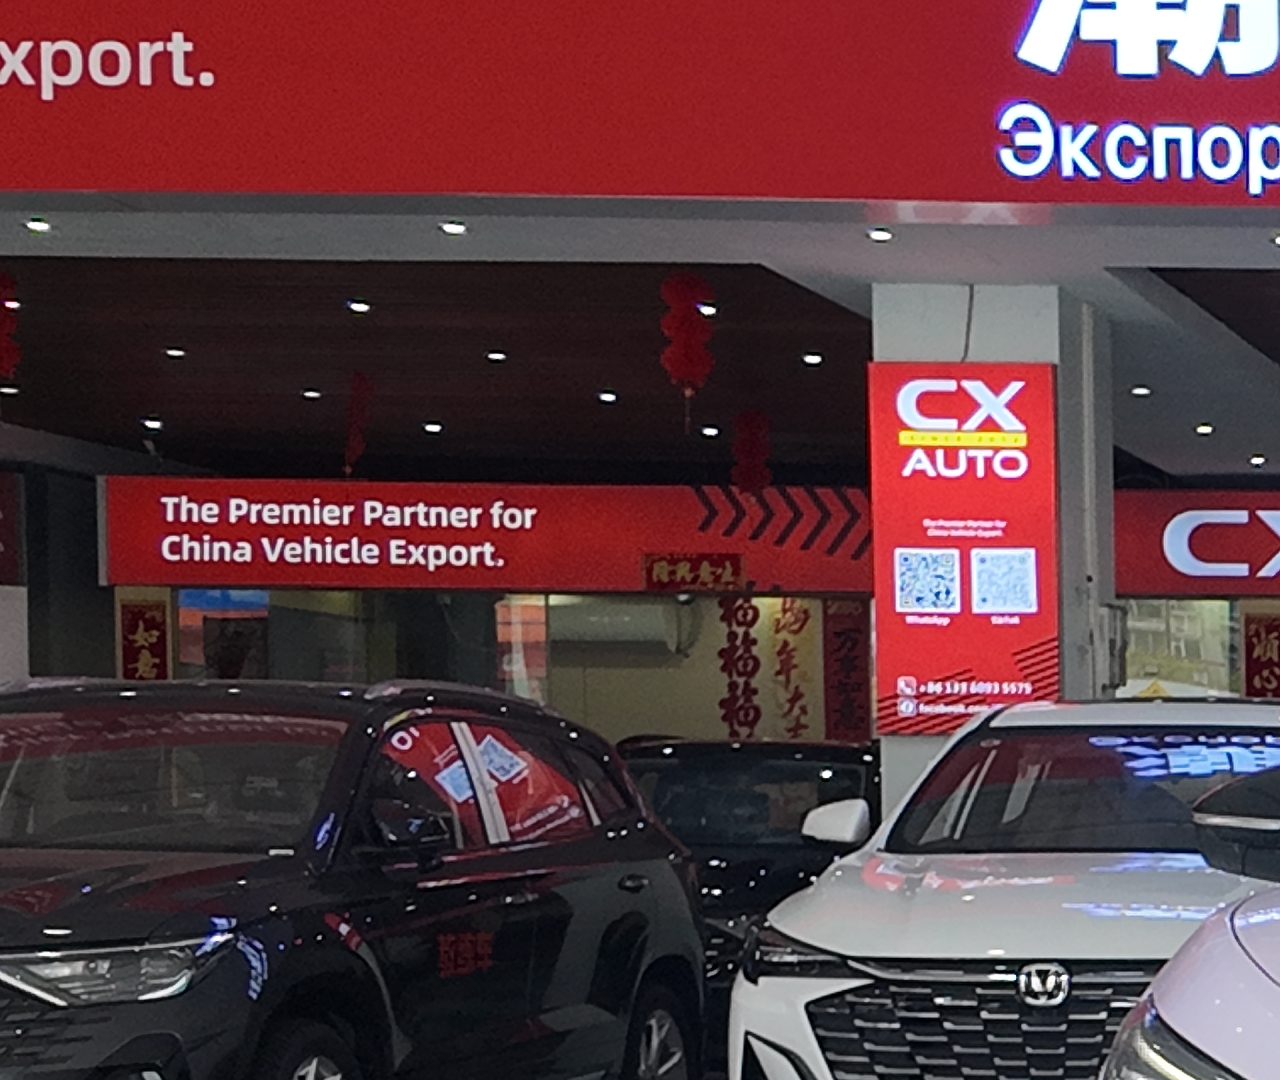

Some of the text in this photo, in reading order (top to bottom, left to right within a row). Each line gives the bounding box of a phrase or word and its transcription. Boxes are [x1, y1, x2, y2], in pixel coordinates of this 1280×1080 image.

[896, 379, 1027, 431] CX
[901, 448, 1029, 479] AUTO
[160, 495, 537, 530] The Premier Partner for
[161, 534, 505, 572] China Vehicle Export.
